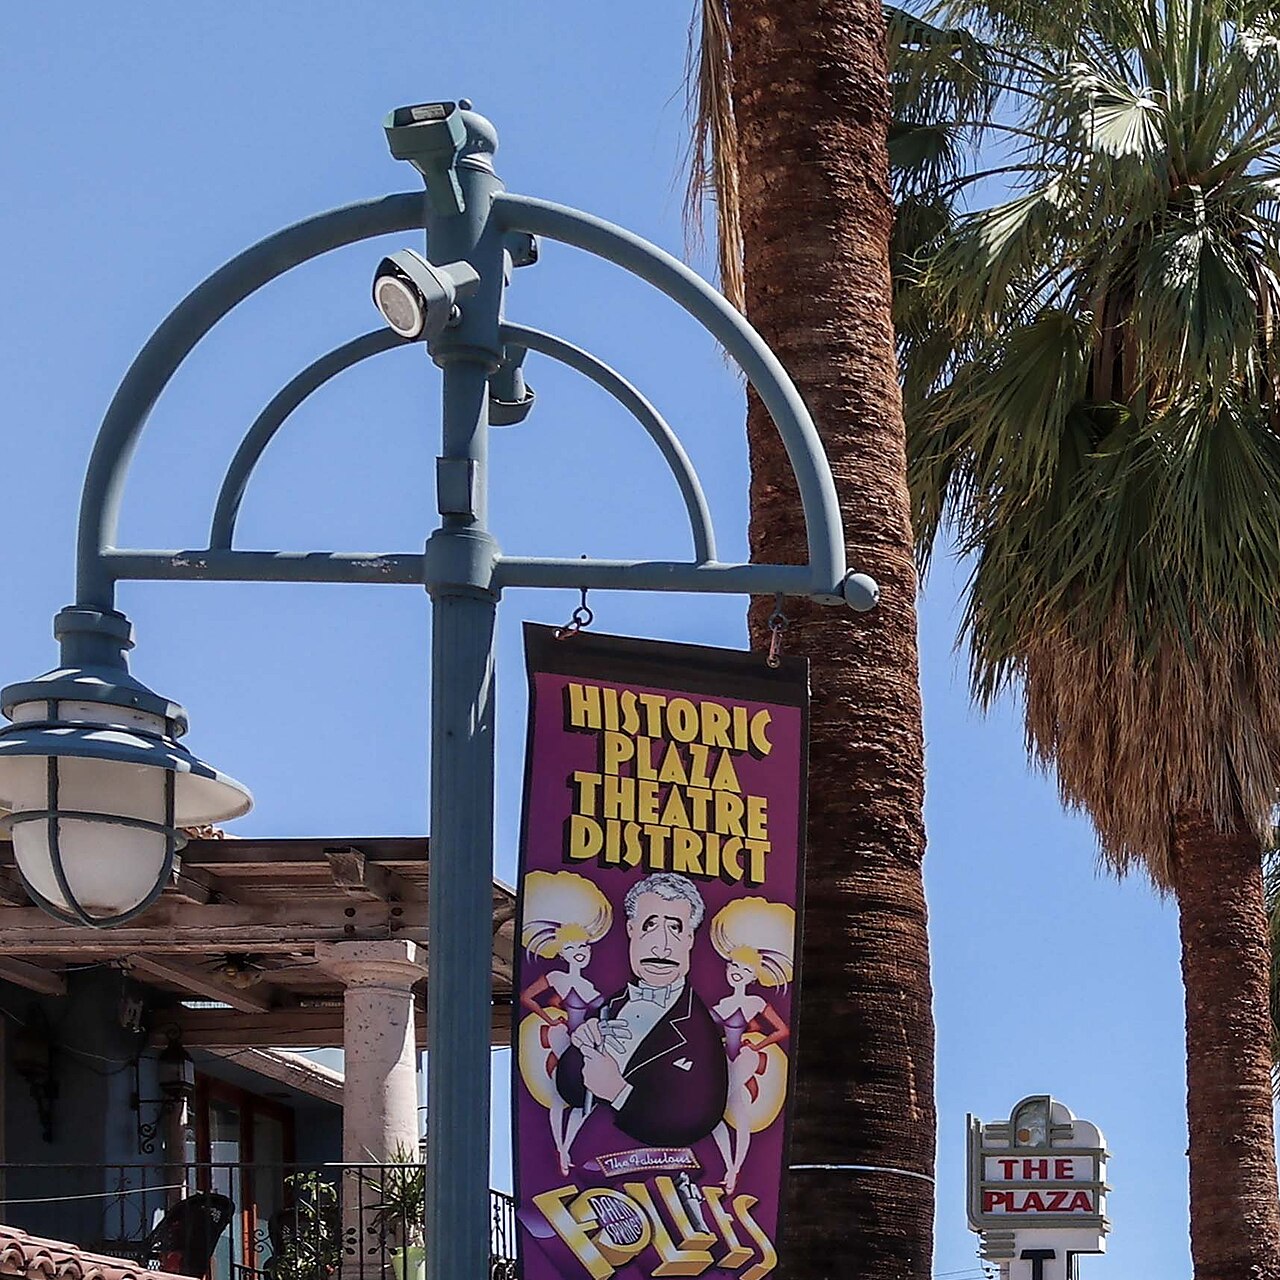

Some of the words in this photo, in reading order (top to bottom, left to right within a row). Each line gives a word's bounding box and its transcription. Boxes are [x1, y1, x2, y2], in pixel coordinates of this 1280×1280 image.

[569, 684, 772, 754] HISTORIC
[603, 732, 742, 792] PLAZA
[574, 771, 768, 840] THEATRE
[568, 814, 771, 885] DISTRICT
[606, 1157, 628, 1171] The
[628, 1152, 692, 1168] Fabulous
[999, 1159, 1075, 1180] THE
[982, 1190, 1094, 1213] PLAZA
